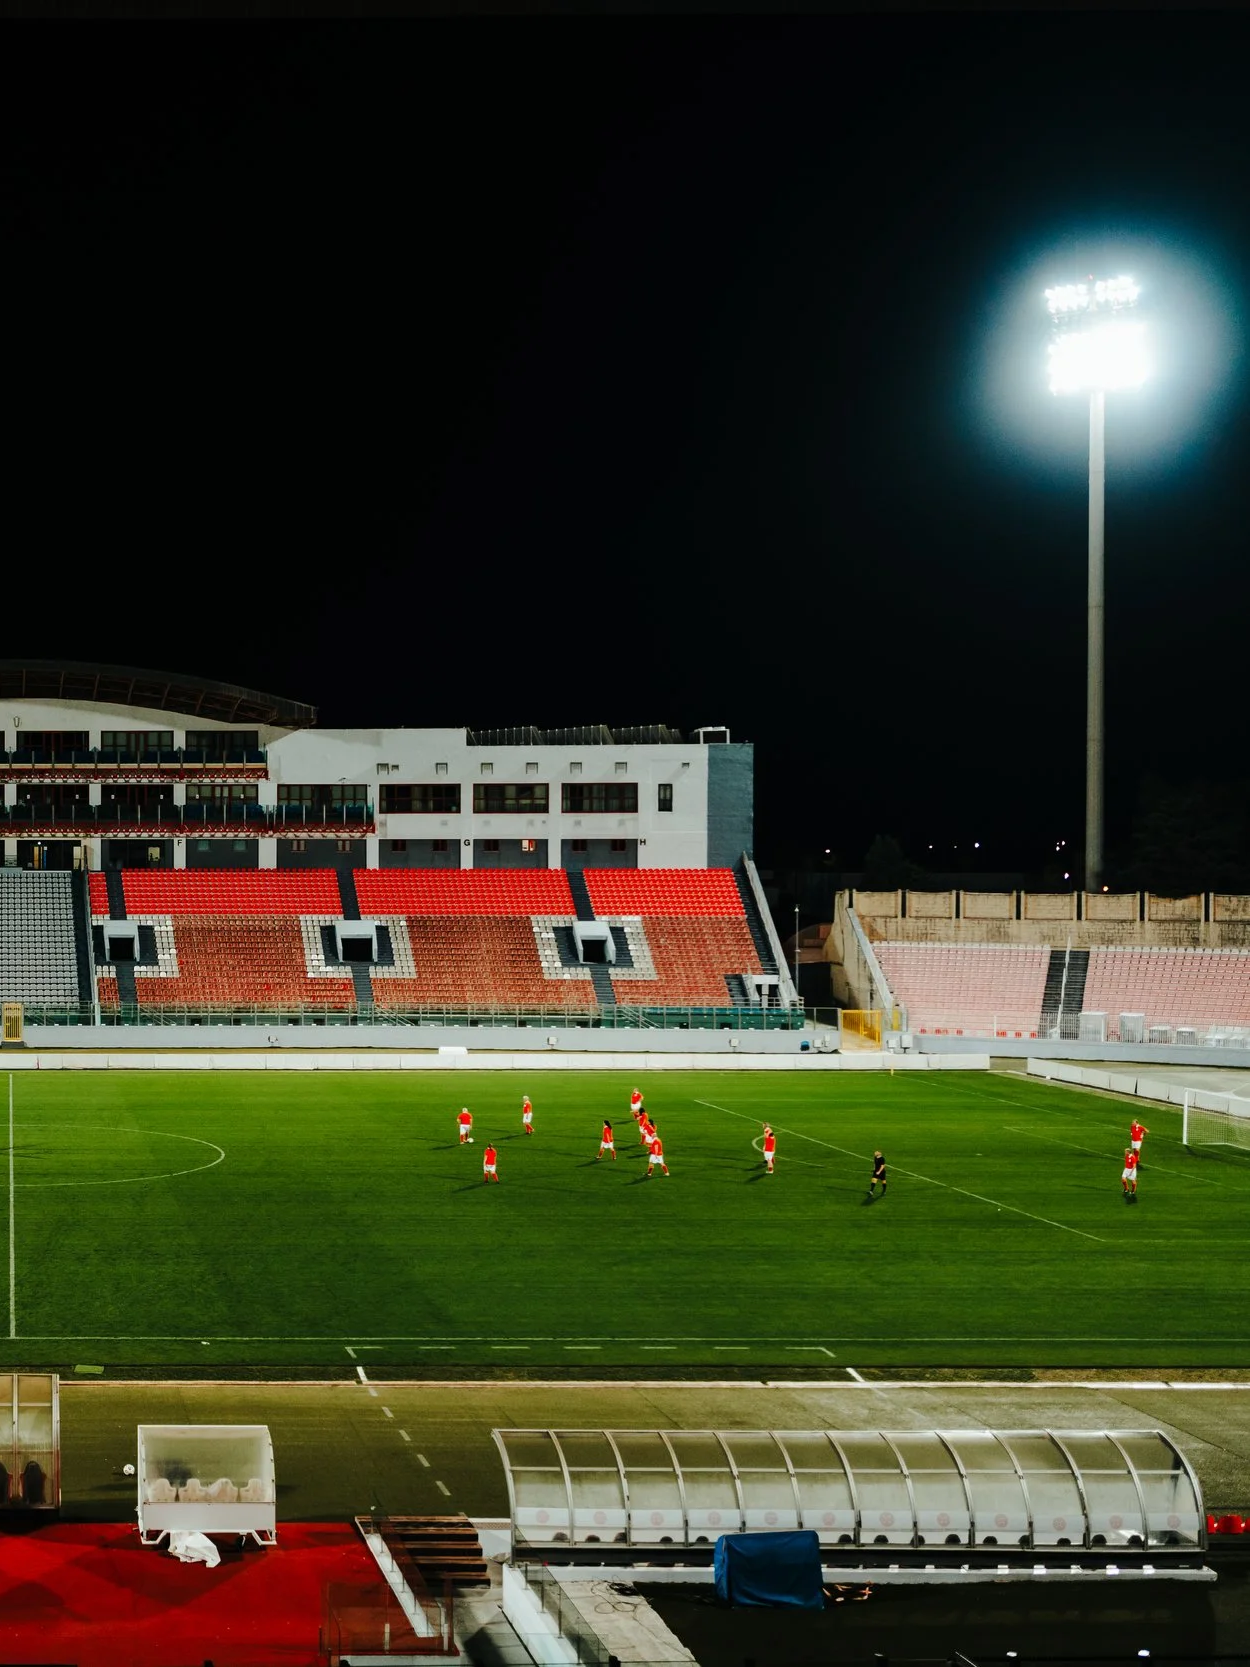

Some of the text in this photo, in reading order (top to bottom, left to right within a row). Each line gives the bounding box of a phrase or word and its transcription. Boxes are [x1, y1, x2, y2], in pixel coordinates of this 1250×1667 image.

[176, 838, 183, 847] F
[463, 838, 471, 847] G
[639, 838, 647, 846] H
